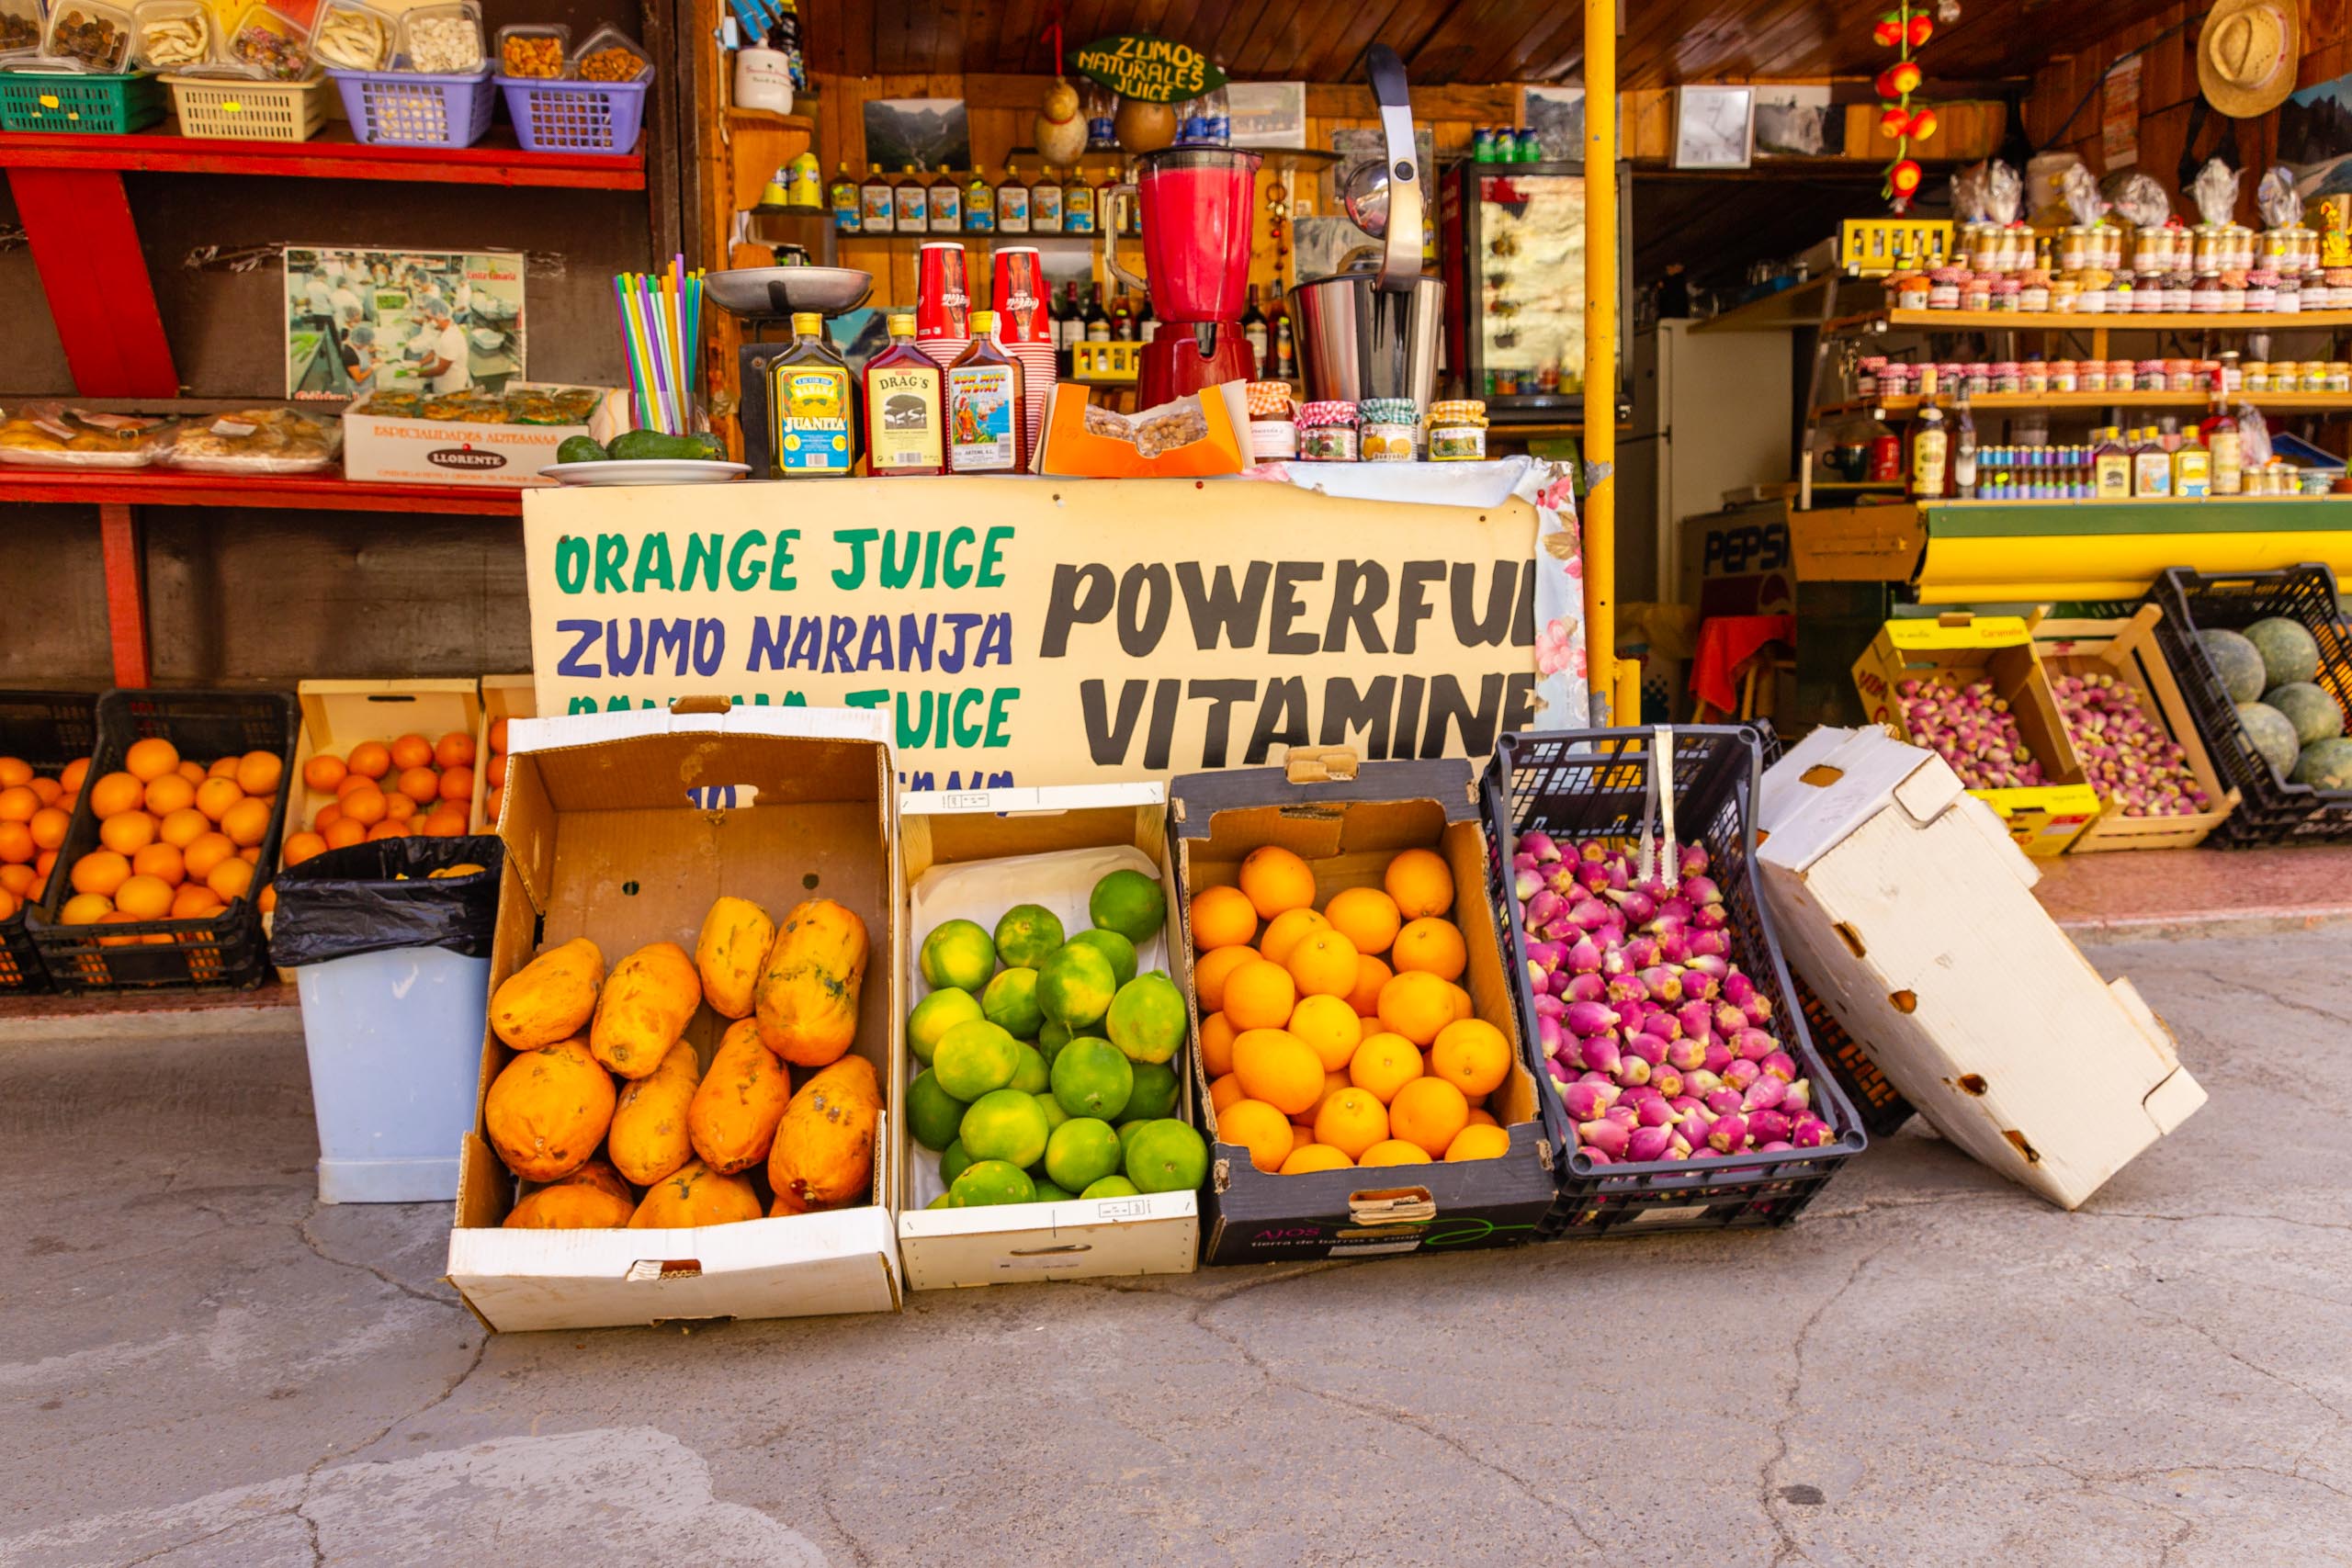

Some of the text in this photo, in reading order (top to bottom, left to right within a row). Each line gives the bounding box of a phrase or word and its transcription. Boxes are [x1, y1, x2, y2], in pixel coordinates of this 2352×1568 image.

[1077, 51, 1204, 93] NATURALES
[1115, 37, 1205, 72] ZUMOS
[1113, 76, 1174, 102] JUICE
[784, 416, 846, 433] JUANITA
[433, 453, 502, 466] LLORENTE
[555, 526, 1015, 595] ORANGE JUICE
[1703, 522, 1791, 576] PEPSI
[557, 612, 1012, 679] ZUMO NARANJA
[1255, 1227, 1321, 1240] AJOS
